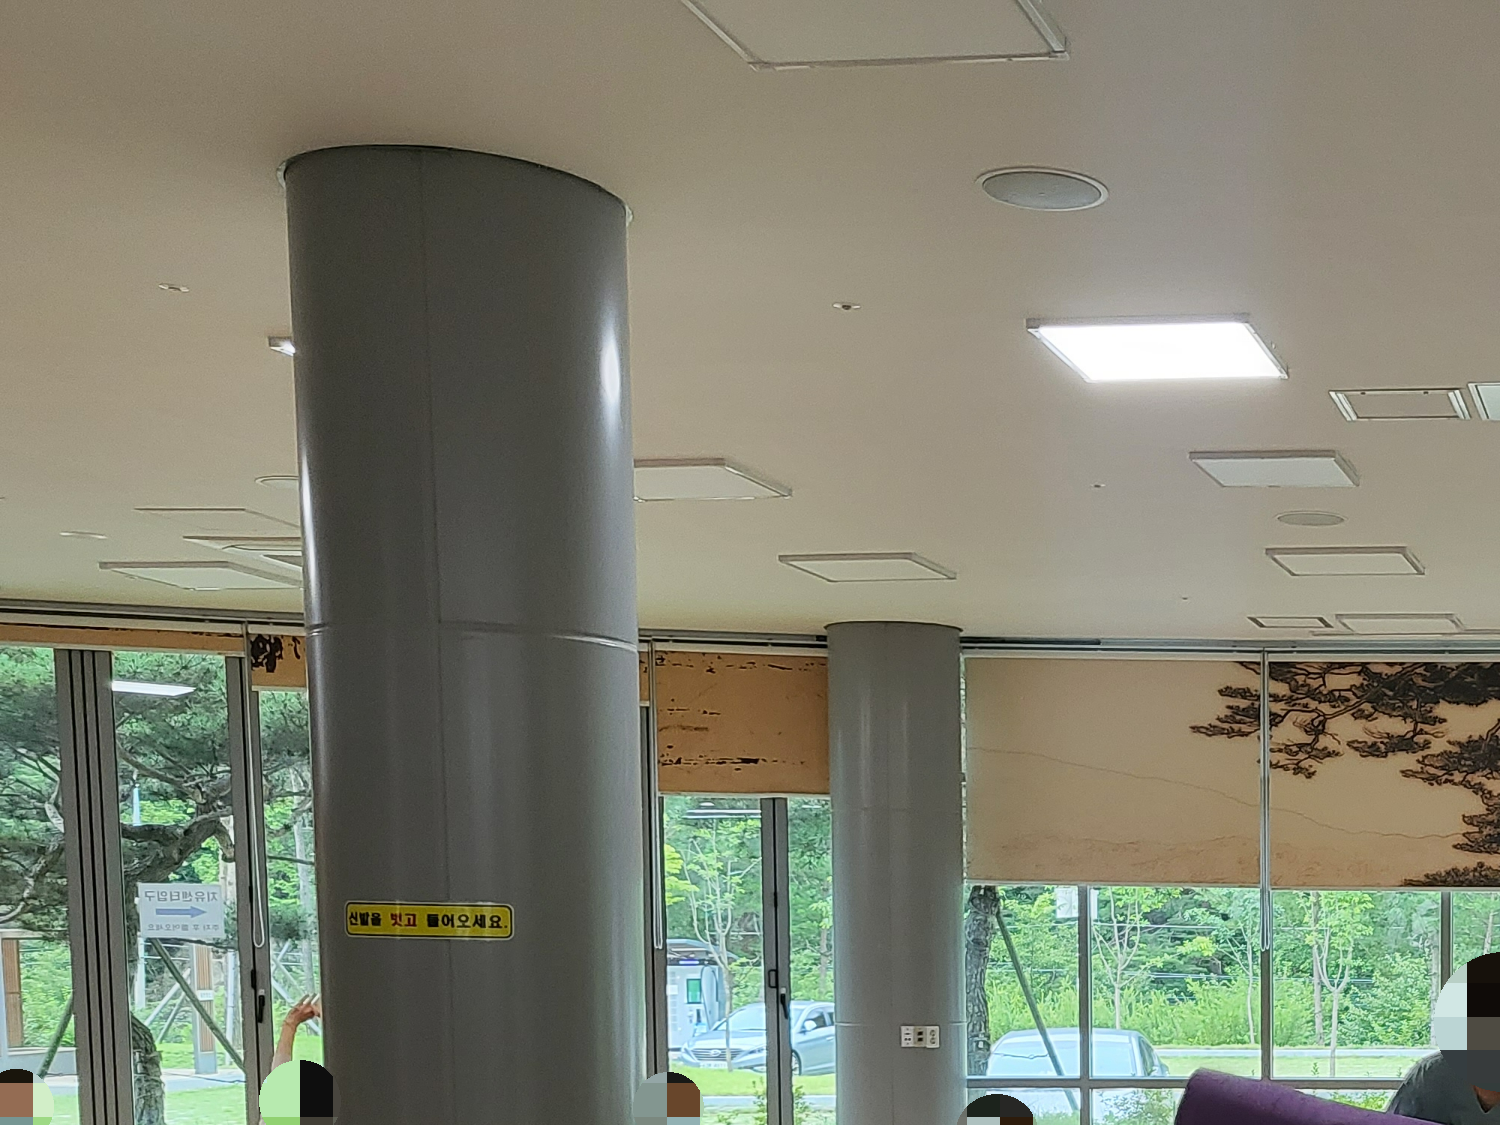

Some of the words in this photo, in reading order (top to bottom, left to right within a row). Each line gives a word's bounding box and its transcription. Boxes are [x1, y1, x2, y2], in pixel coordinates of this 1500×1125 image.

[349, 912, 382, 926] 신발을
[390, 912, 417, 927] 벗고
[426, 913, 508, 929] 들어오세요.
